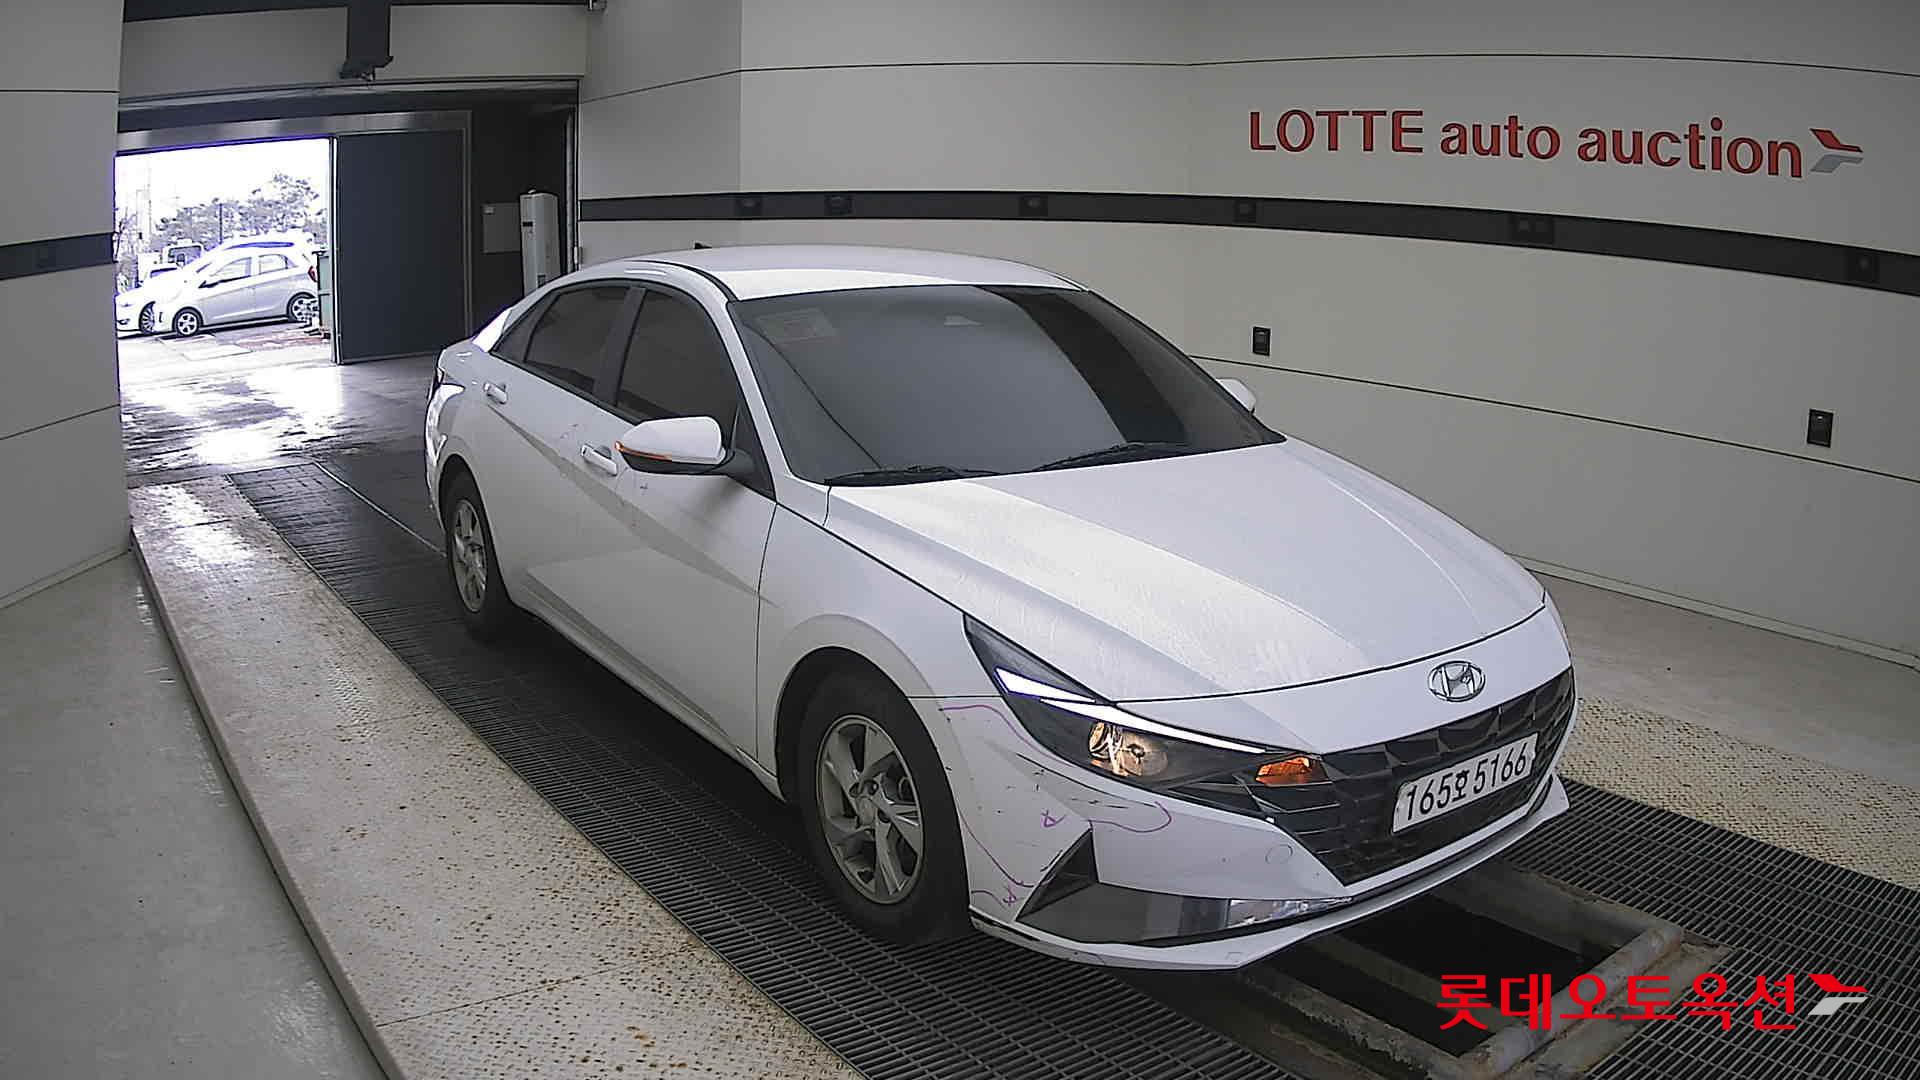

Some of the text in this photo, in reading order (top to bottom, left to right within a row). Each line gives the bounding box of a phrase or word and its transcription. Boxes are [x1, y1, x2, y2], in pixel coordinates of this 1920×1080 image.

[1250, 111, 1803, 178] LOTTE auto auction
